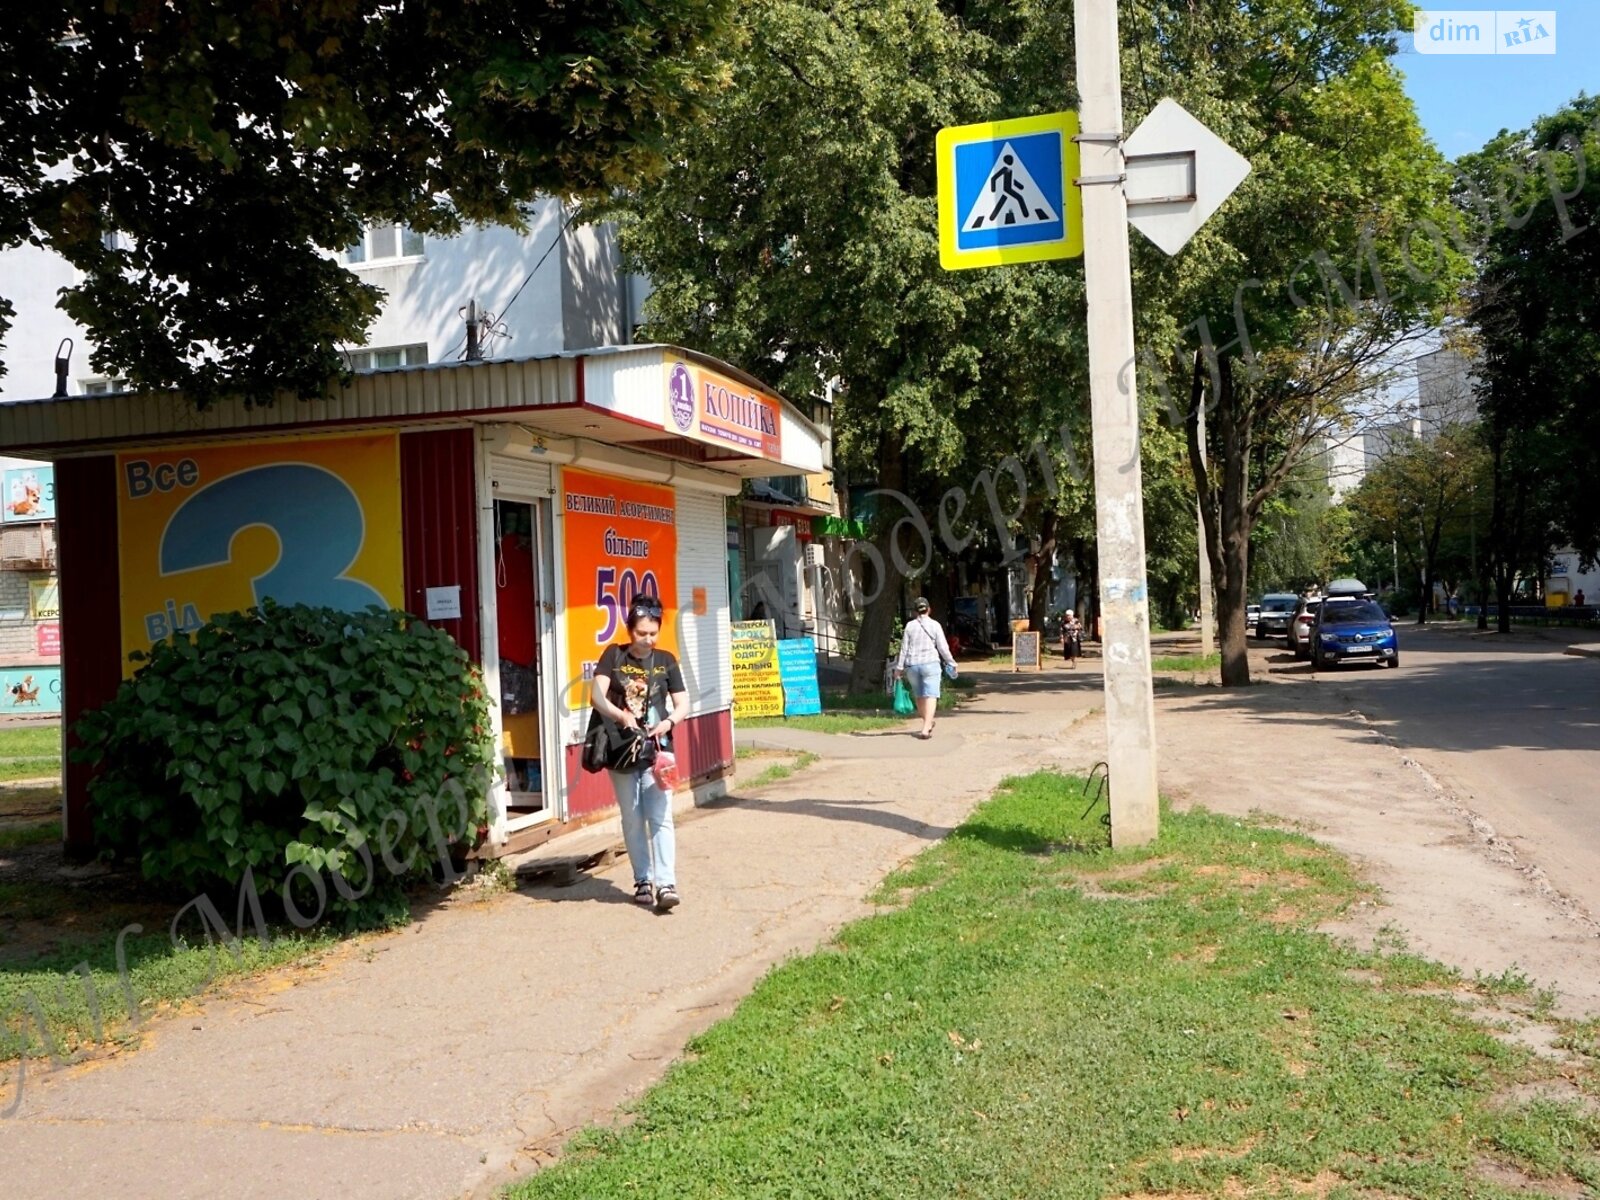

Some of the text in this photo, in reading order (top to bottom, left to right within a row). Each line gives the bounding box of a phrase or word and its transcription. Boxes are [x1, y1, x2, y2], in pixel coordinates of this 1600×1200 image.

[704, 382, 777, 437] КОПІЙКА
[125, 457, 199, 499] Все
[566, 492, 617, 516] ВЕЛИКИЙ
[603, 526, 649, 559] більше
[144, 598, 205, 642] від
[595, 566, 660, 645] 500
[735, 650, 766, 660] ОДЯГУ
